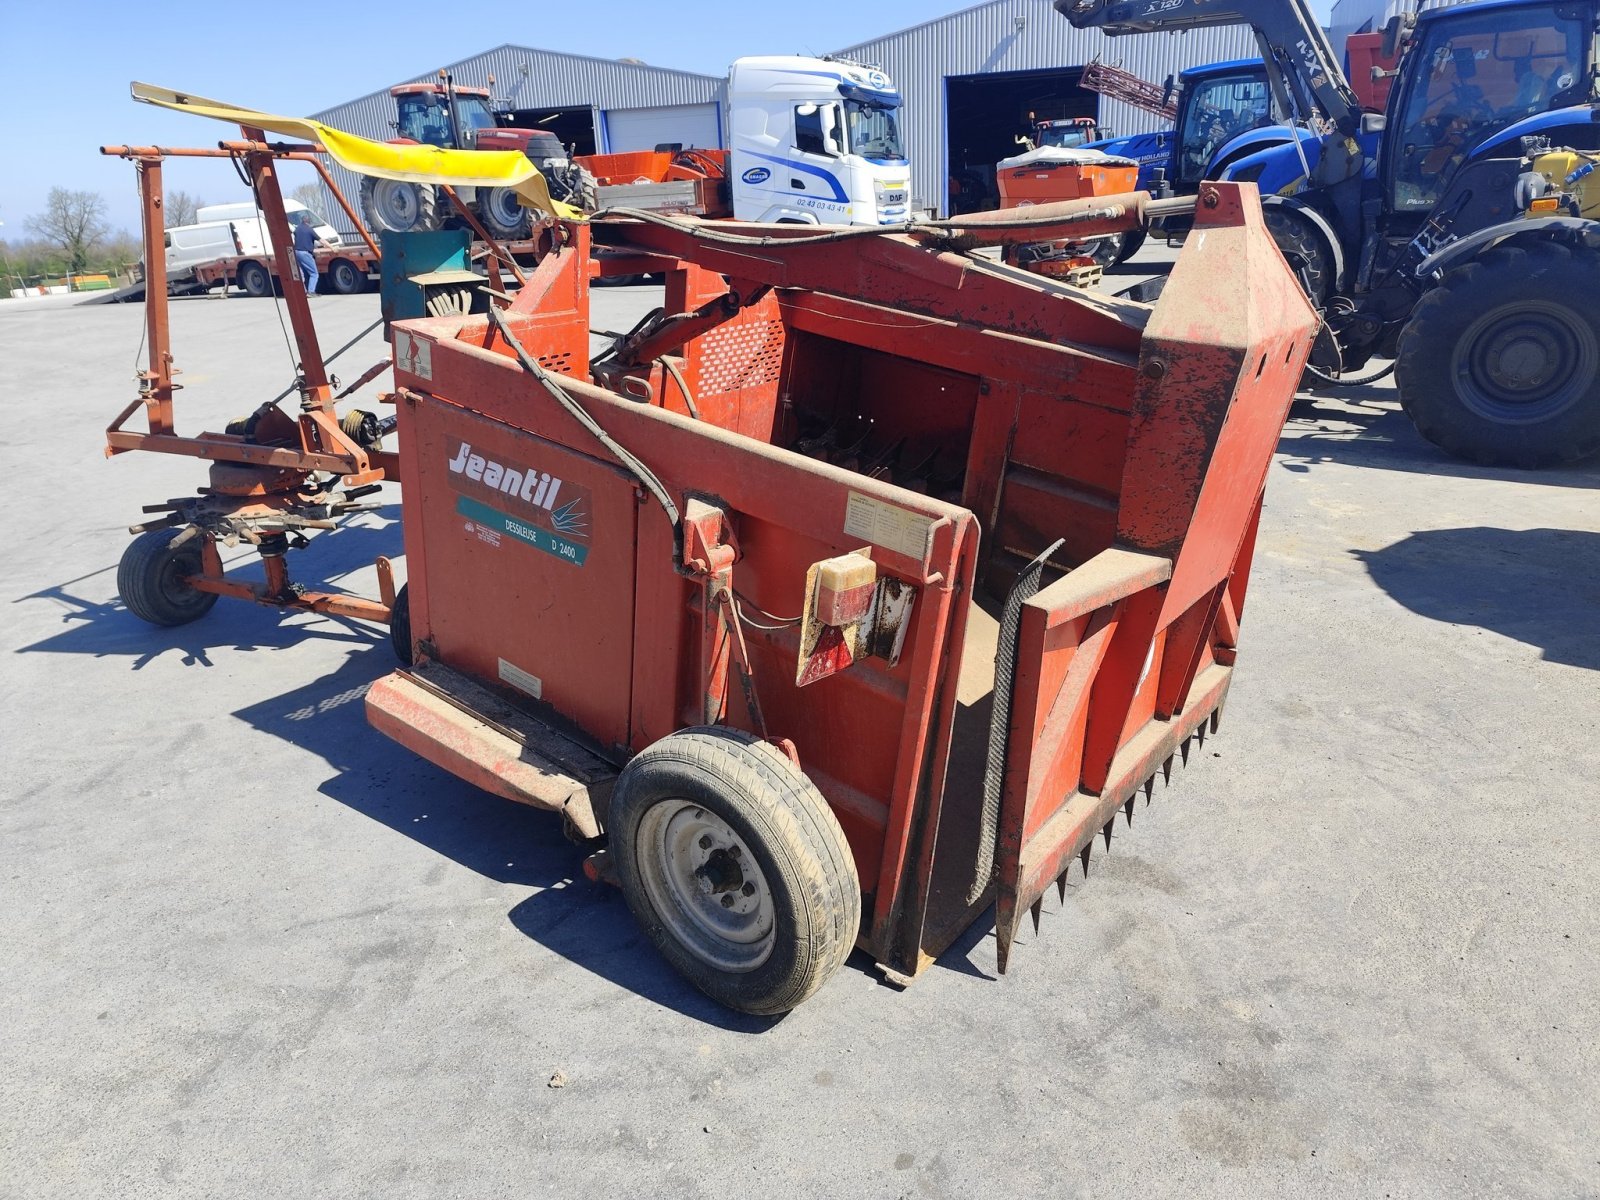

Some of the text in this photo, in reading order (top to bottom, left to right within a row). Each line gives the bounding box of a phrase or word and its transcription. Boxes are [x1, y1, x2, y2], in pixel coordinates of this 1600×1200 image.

[1141, 152, 1170, 161] HOLLAND
[797, 198, 806, 206] 02
[889, 194, 903, 202] DAF
[449, 442, 562, 511] Jeantil
[505, 519, 537, 543] DESSILEUSE
[551, 540, 557, 551] D
[559, 544, 576, 559] 2400
